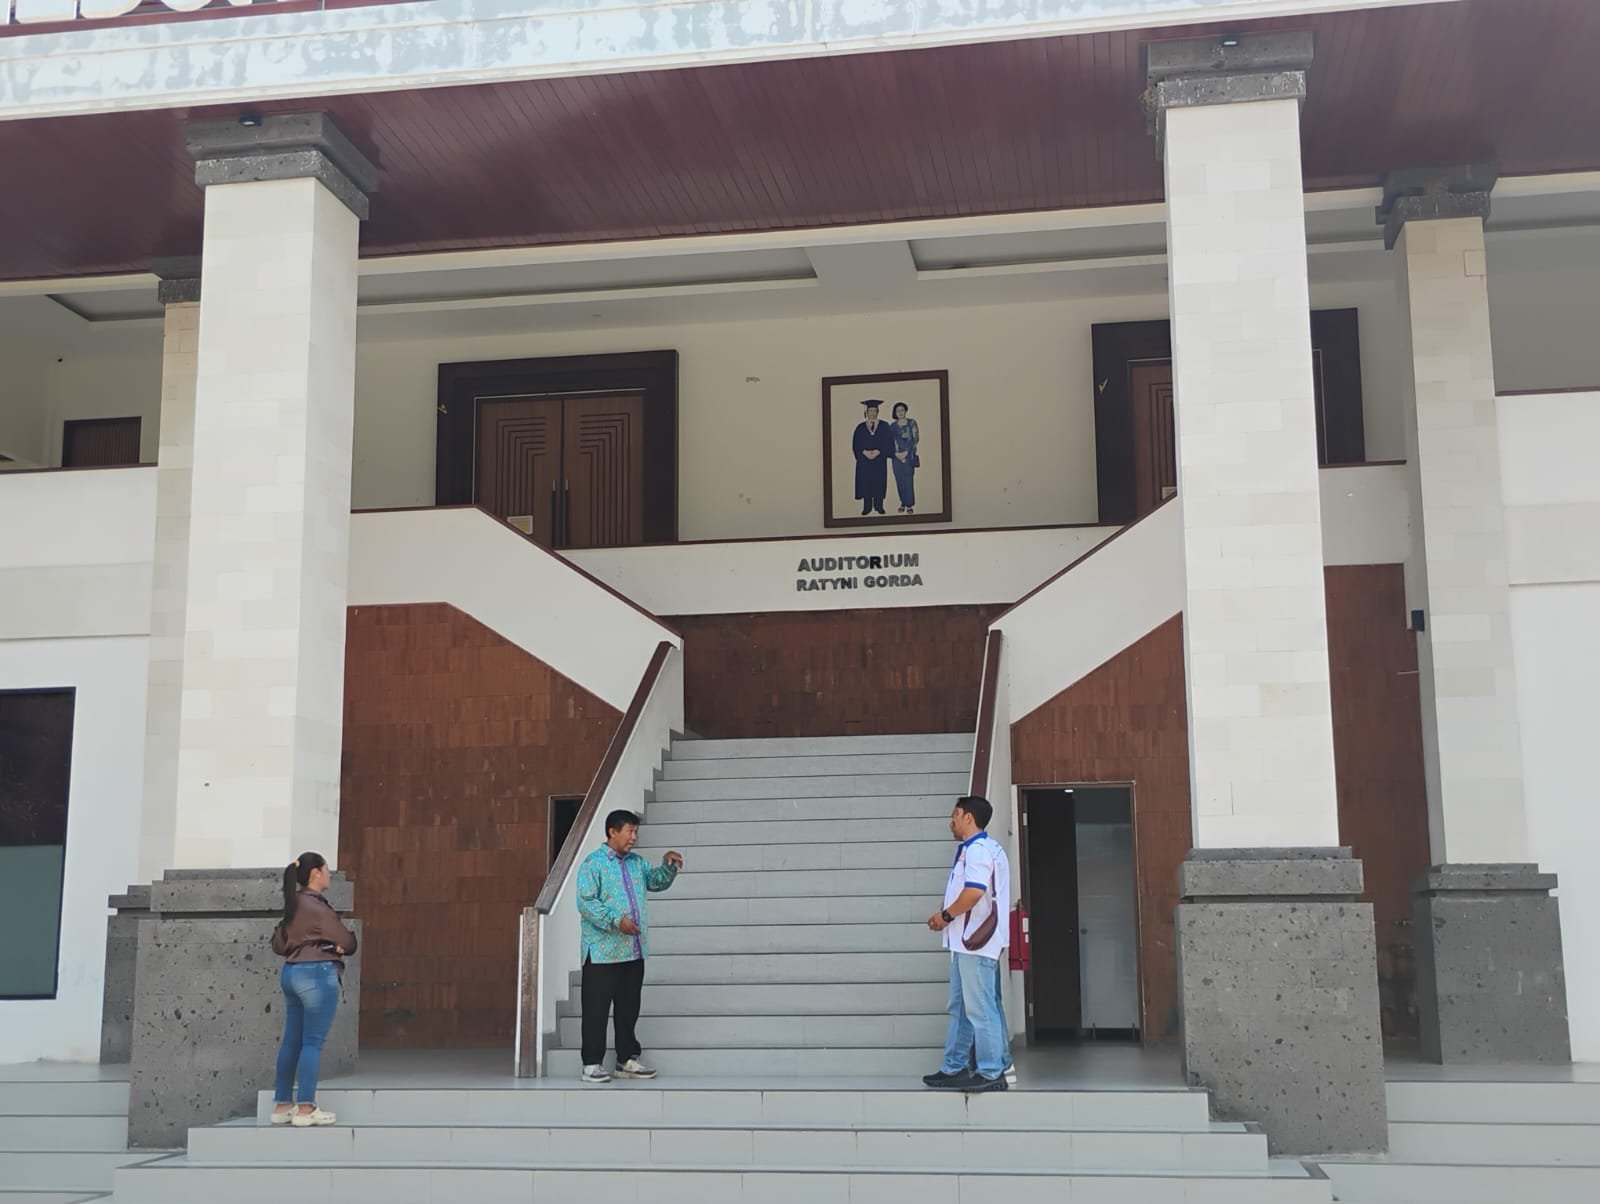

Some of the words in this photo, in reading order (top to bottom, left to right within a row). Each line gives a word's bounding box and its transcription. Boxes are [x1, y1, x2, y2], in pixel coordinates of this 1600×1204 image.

[797, 553, 919, 572] AUDITORIUM
[796, 577, 858, 592] RATYNI
[863, 574, 923, 588] GORDA
